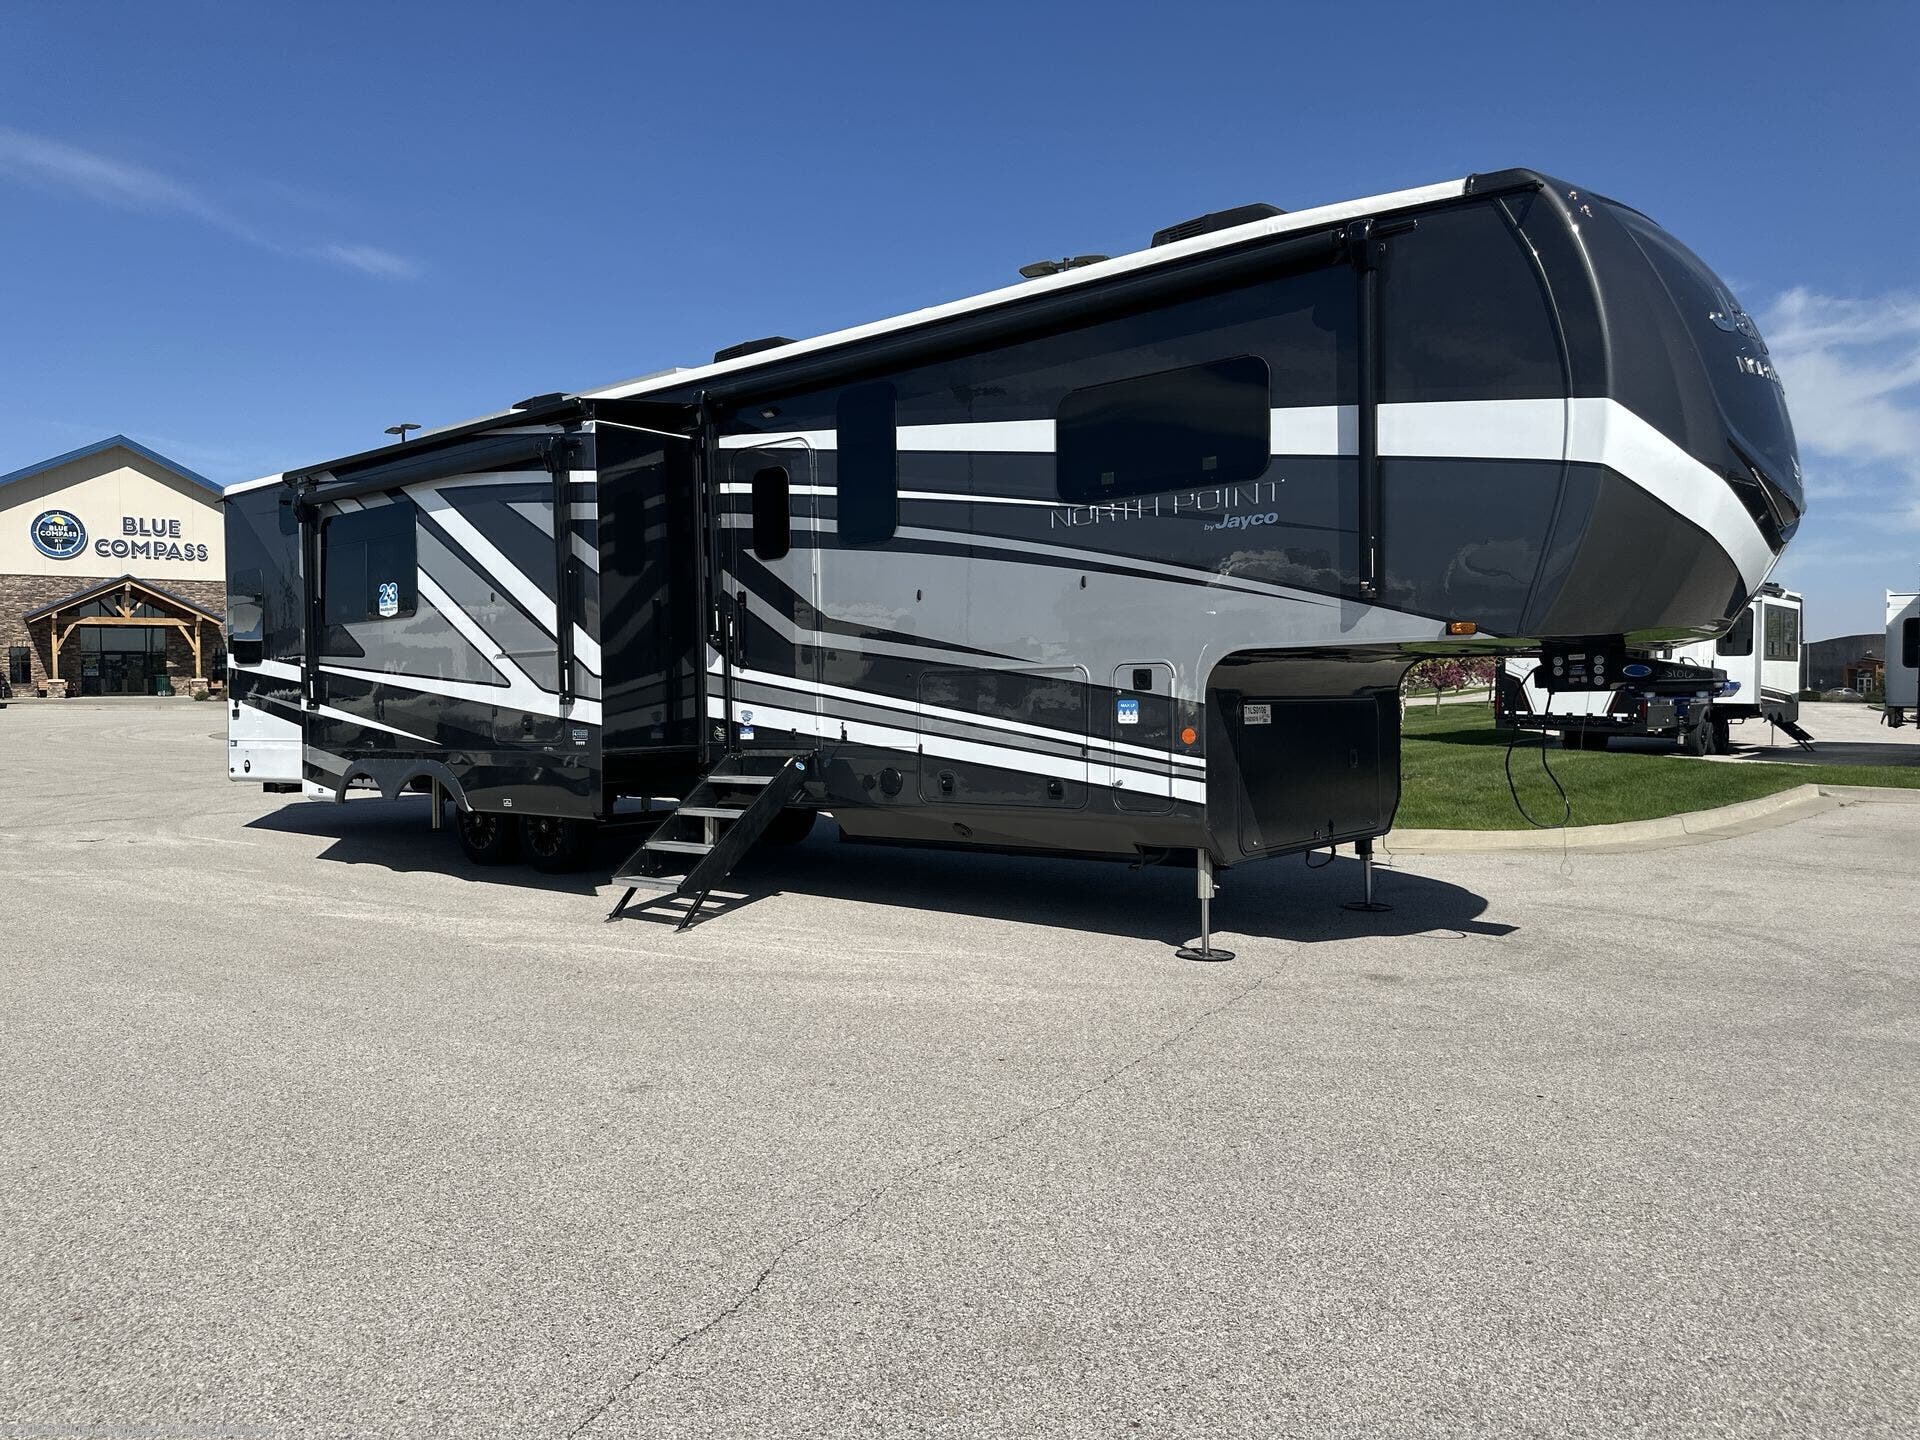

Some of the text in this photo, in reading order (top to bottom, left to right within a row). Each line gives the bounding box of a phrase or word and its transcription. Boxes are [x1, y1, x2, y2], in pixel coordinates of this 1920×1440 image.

[1051, 480, 1284, 529] NORTH POINT
[122, 516, 181, 539] BLUE
[1204, 512, 1279, 531] by Jayco
[94, 538, 209, 562] COMPASS
